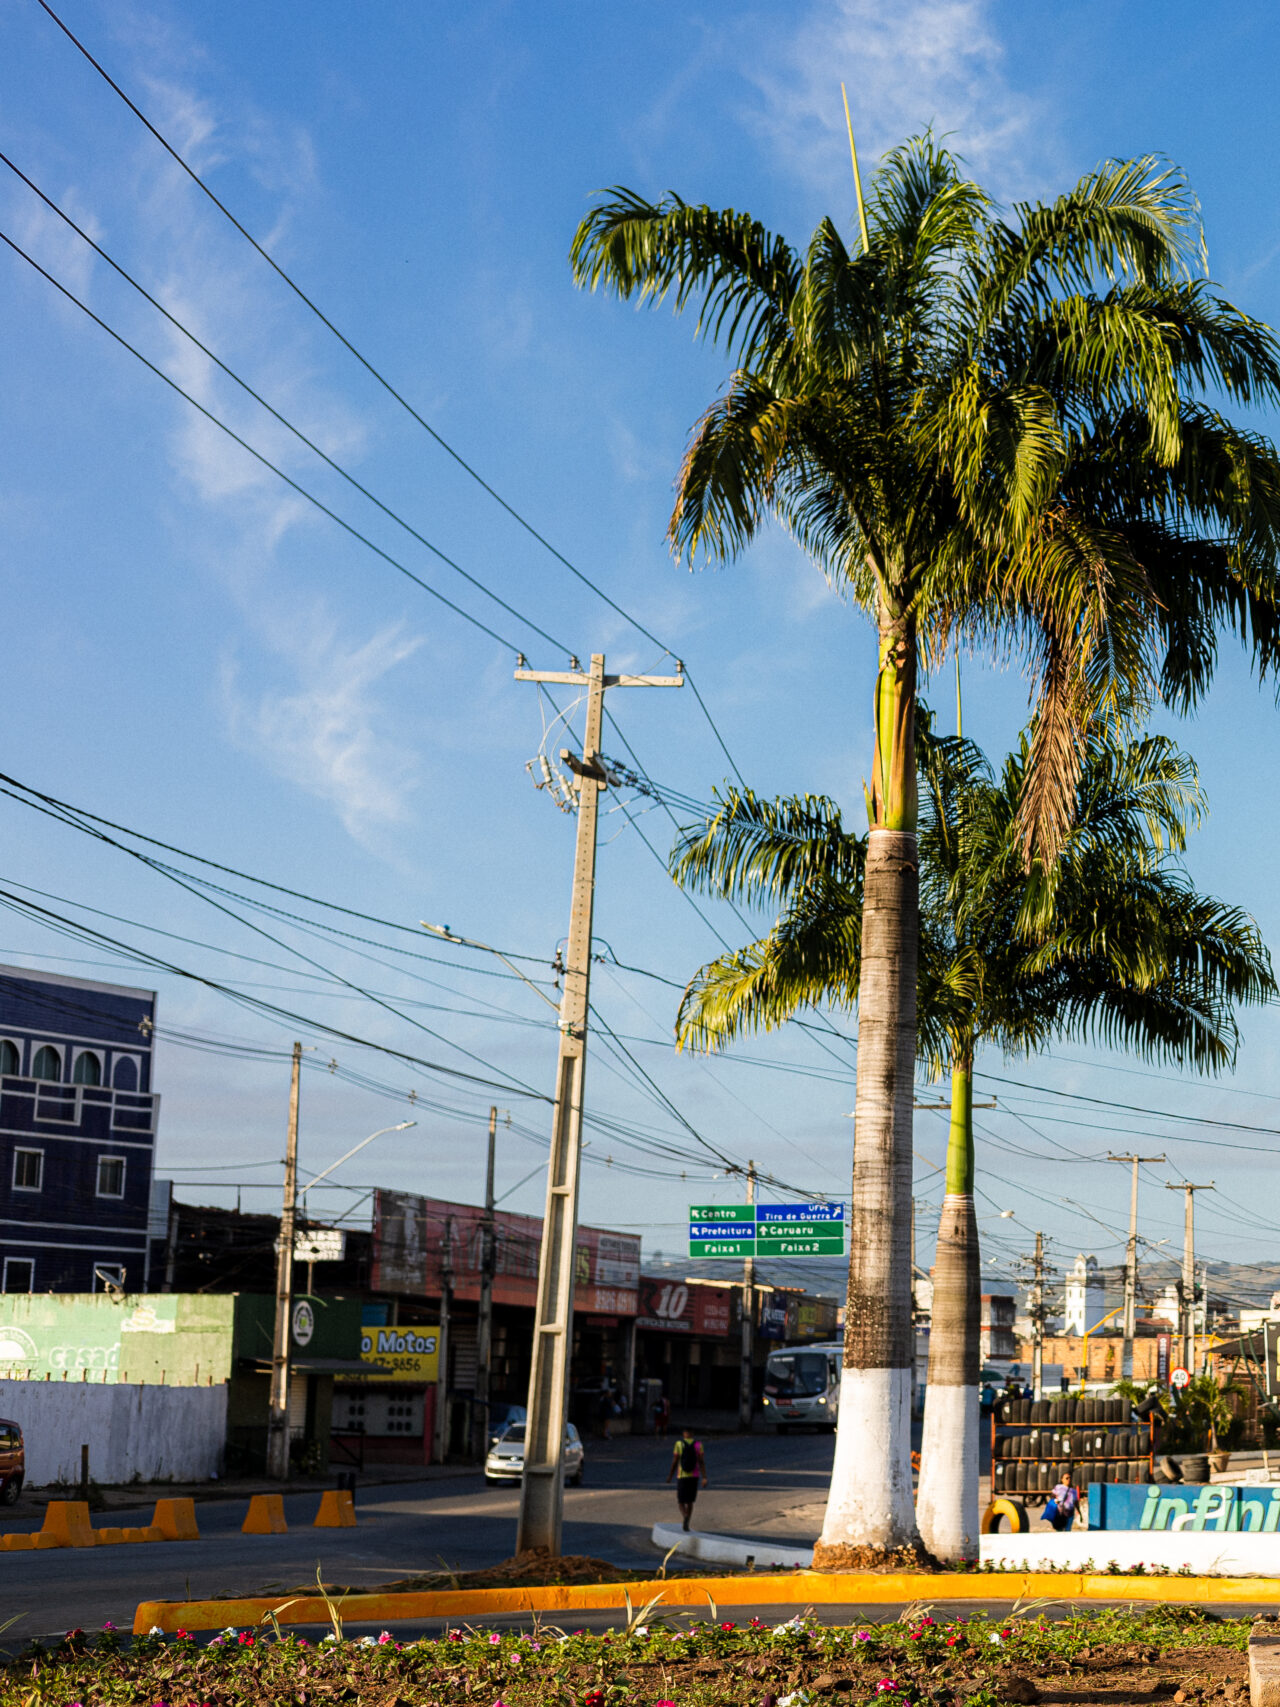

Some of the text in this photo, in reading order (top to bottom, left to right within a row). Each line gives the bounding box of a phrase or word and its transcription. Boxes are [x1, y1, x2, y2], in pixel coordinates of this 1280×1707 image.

[701, 1209, 736, 1218] Centro
[799, 1212, 831, 1220] Guerra
[701, 1227, 752, 1235] Prefeitura
[769, 1226, 814, 1235] Caruaru
[704, 1244, 735, 1253] Faixa
[780, 1242, 820, 1252] Faixa 2
[377, 1330, 437, 1354] Motos
[1174, 1372, 1186, 1381] 40
